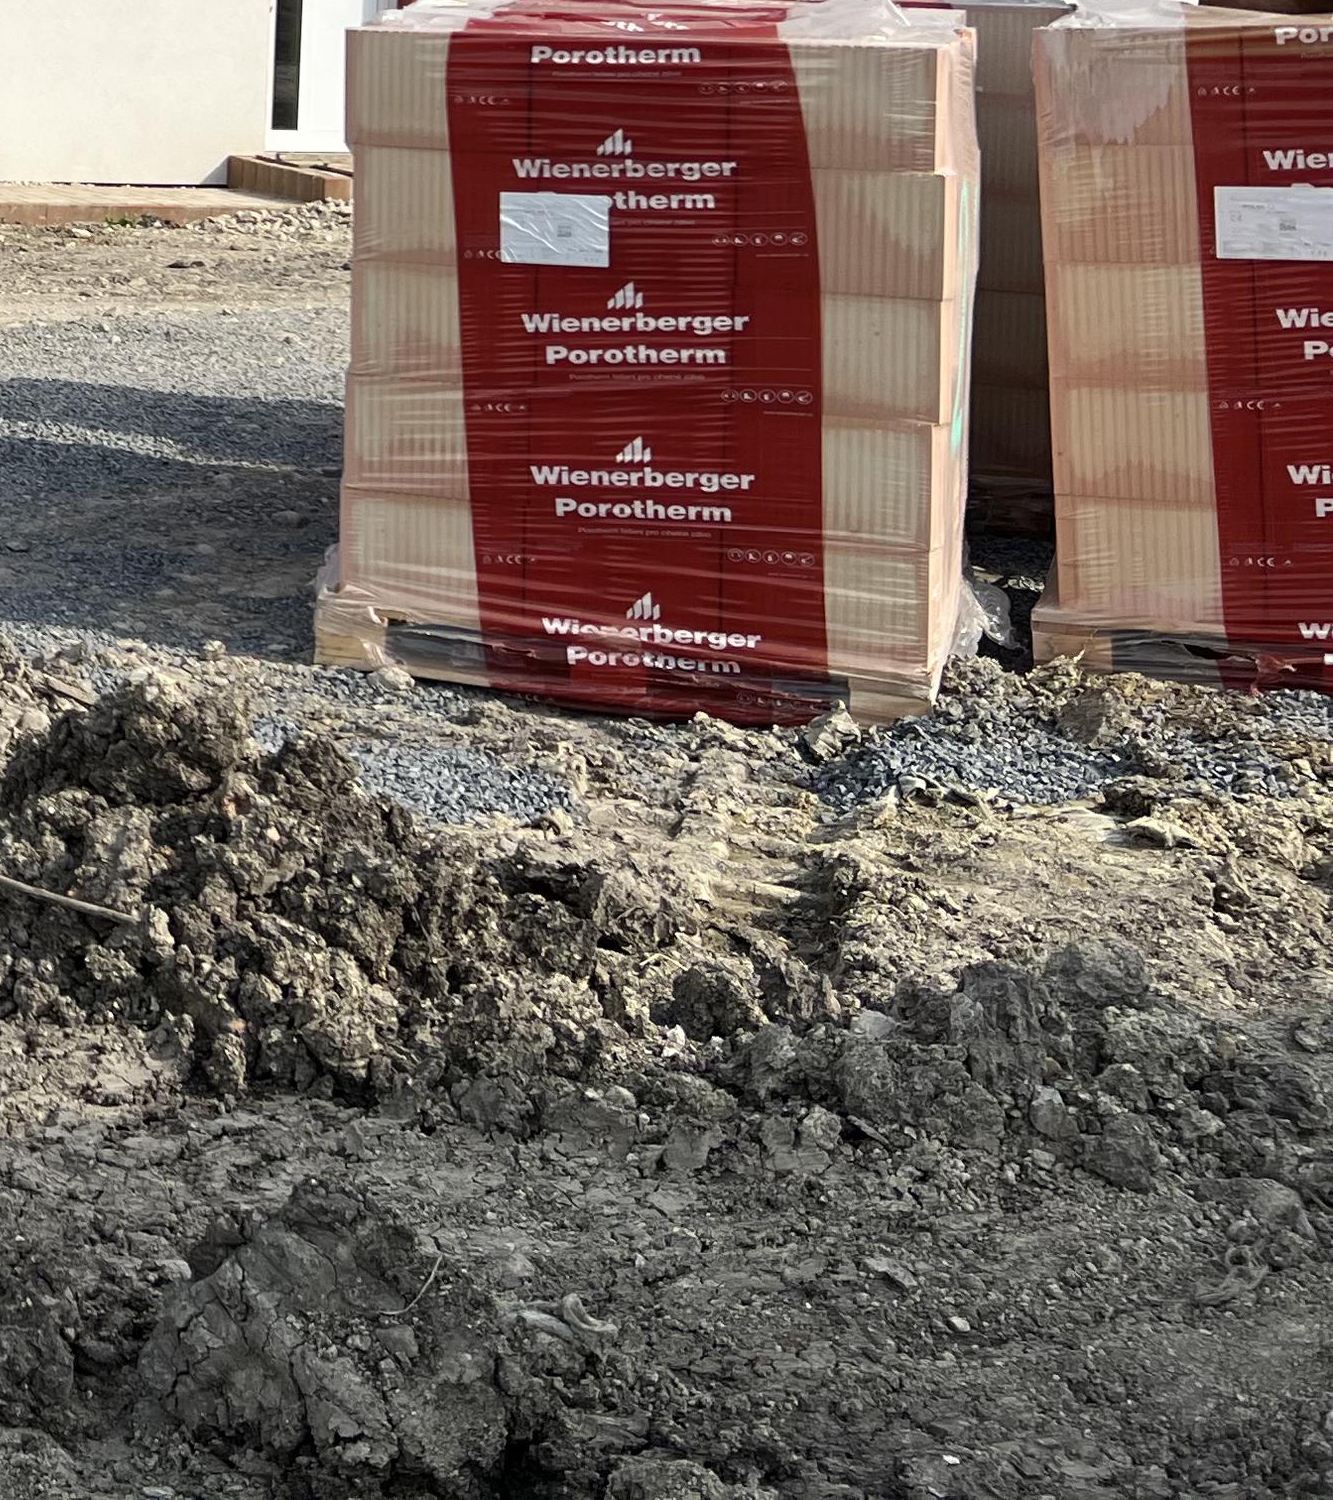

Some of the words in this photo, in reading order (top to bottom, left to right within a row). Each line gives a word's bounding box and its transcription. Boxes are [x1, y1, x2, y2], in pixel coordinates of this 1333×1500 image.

[531, 45, 701, 65] Porotherm
[512, 158, 737, 181] Wienerberger
[521, 313, 749, 335] Wienerberger
[546, 345, 726, 365] Porotherm
[530, 465, 755, 492] Wienerberger
[555, 498, 732, 522] Porotherm
[541, 617, 762, 649] Wienerberger
[566, 646, 741, 674] Porotherm
